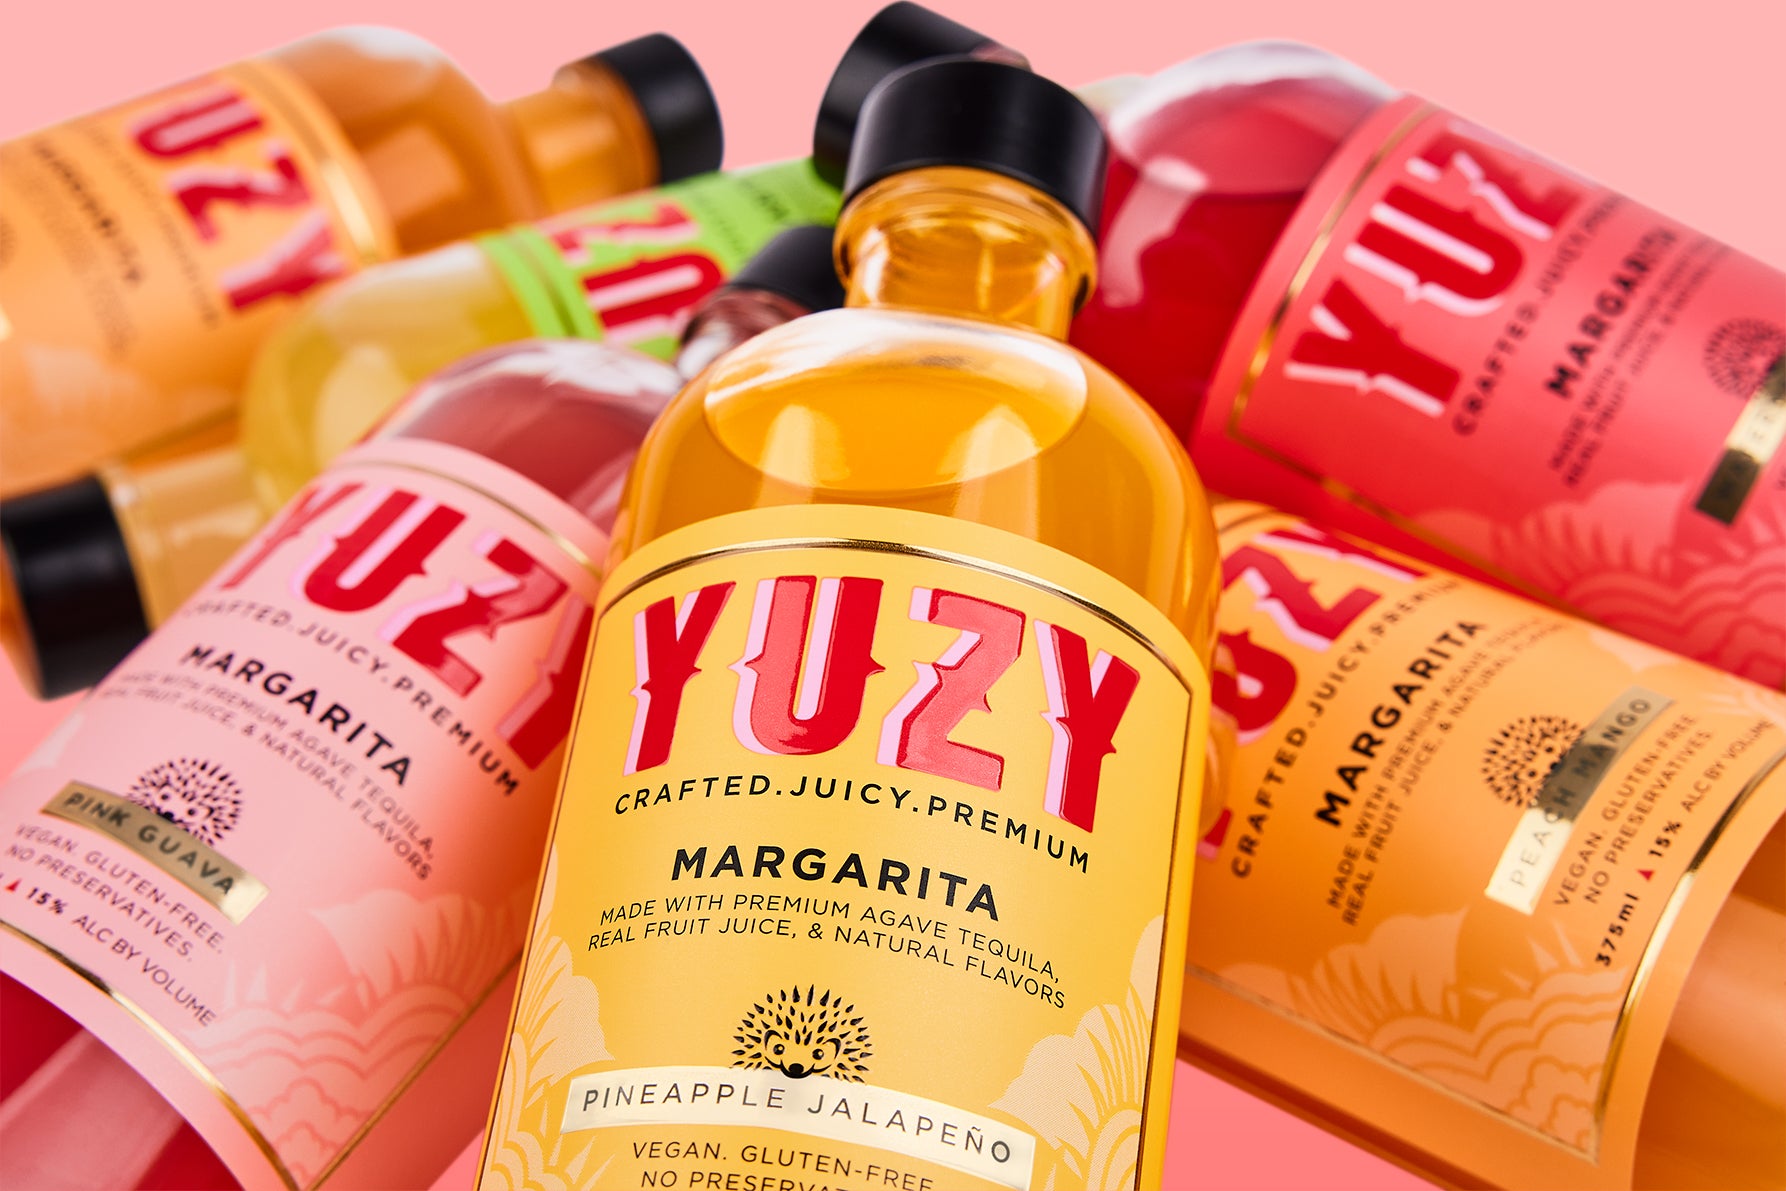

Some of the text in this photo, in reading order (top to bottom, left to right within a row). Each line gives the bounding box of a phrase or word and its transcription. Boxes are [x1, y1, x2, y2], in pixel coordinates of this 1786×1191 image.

[178, 644, 411, 786] MARGARITA
[289, 729, 356, 777] AGAVE
[623, 575, 1141, 834] YUZY
[1315, 620, 1486, 828] MARGARITA
[64, 792, 236, 895] PINK GUAVA
[241, 722, 257, 736] &
[350, 797, 432, 881] FLAVORS
[1326, 844, 1361, 910] MADE
[1353, 785, 1388, 839] WITH
[1510, 698, 1652, 888] PEACH MANGO
[1595, 718, 1777, 968] 375ml 15% ALC BY VOLUME
[671, 845, 999, 922] MARGARITA
[1342, 871, 1375, 927] REAL
[1366, 800, 1402, 864] FRUIT
[1584, 870, 1611, 905] NO
[26, 886, 217, 1027] 15% ALC BY VOLUME
[588, 917, 1066, 1009] REAL FRUIT JUICE, & NATURAL FLAVORS
[600, 894, 1060, 984] MADE WITH PREMIUM AGAVE TEQUILA,
[582, 1083, 1013, 1164] PINEAPPLE JALAPEÑO
[633, 1142, 935, 1191] VEGAN. GLUTEN-FREE
[641, 1170, 851, 1191] NO PRESERV
